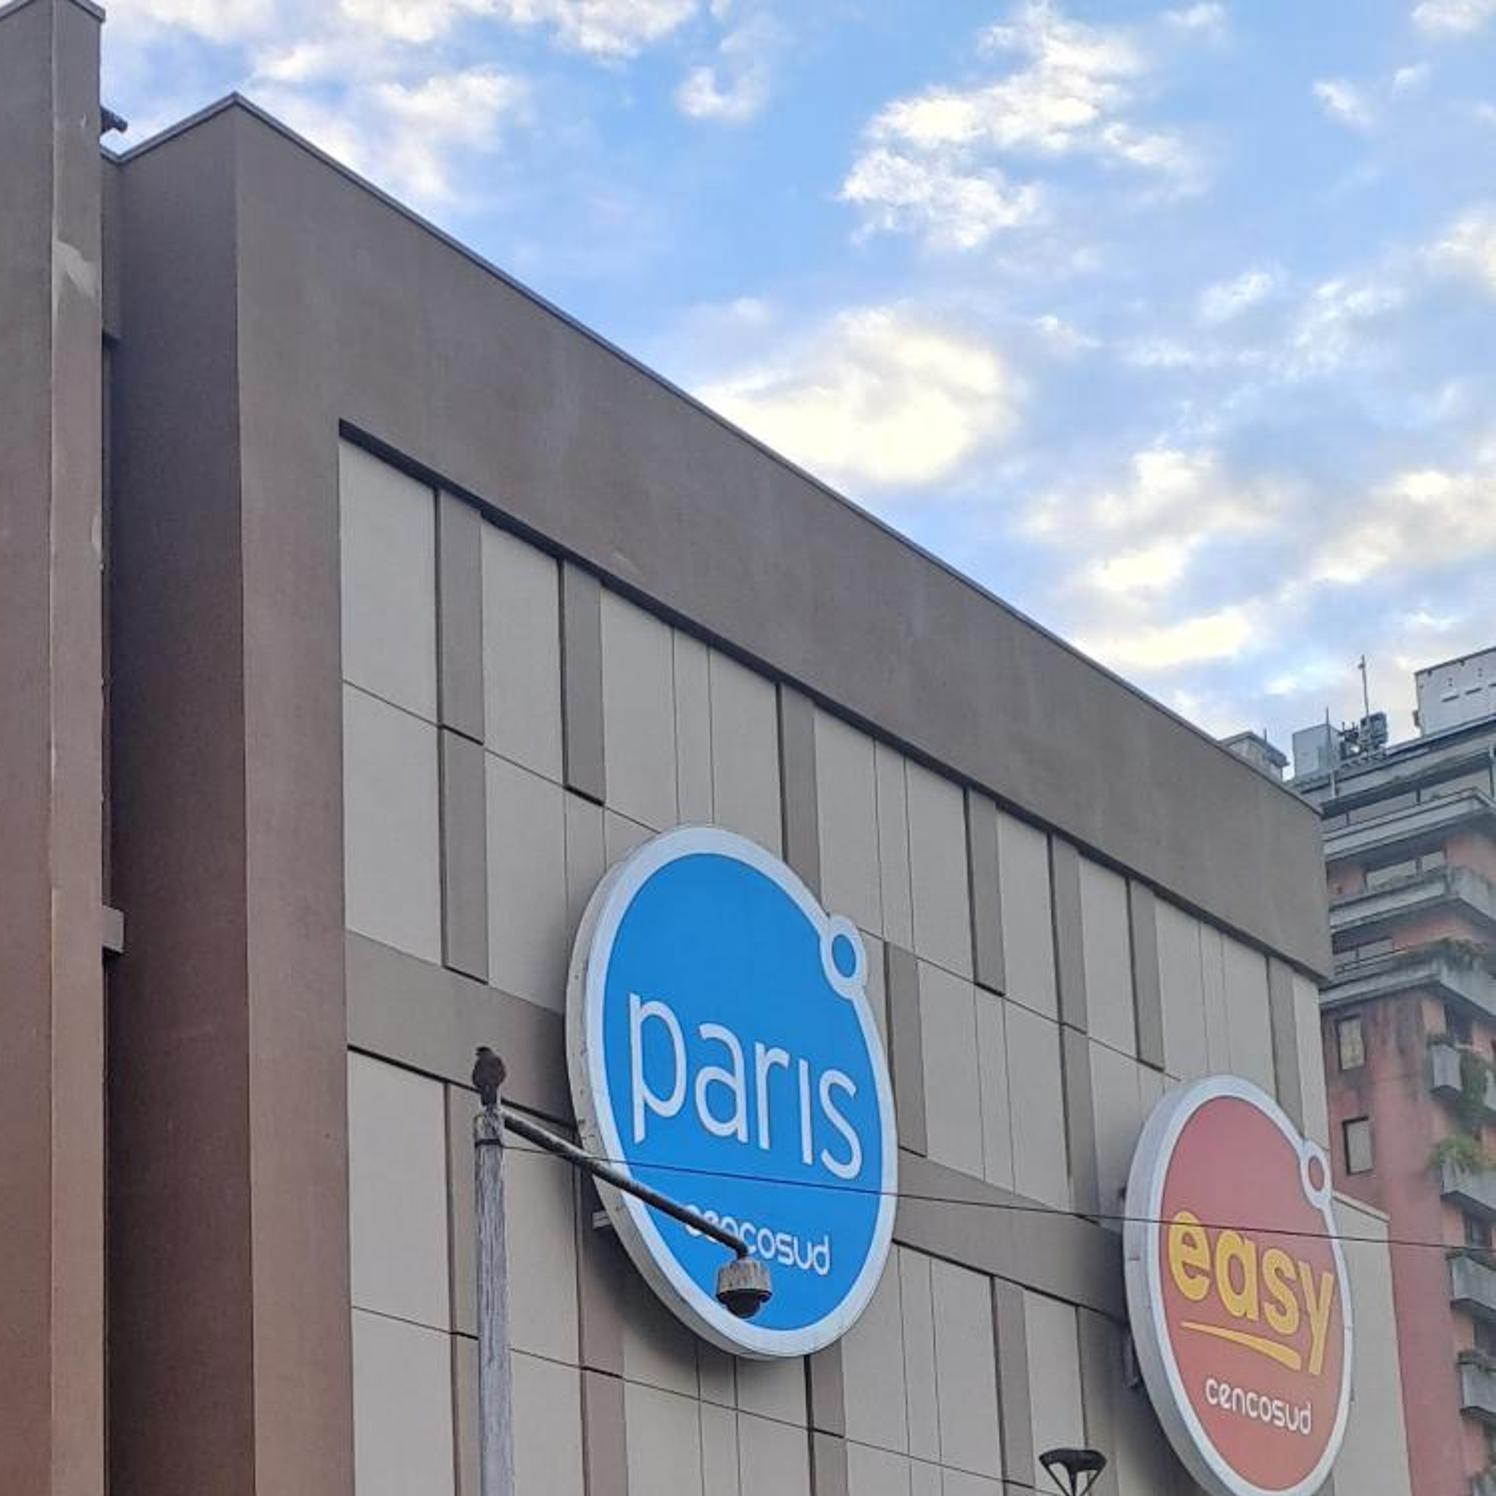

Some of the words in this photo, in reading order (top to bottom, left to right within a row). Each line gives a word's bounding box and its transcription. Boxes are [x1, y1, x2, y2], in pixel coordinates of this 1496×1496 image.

[628, 992, 863, 1180] paris
[1167, 1211, 1335, 1376] easy
[1205, 1377, 1312, 1436] cencosud
